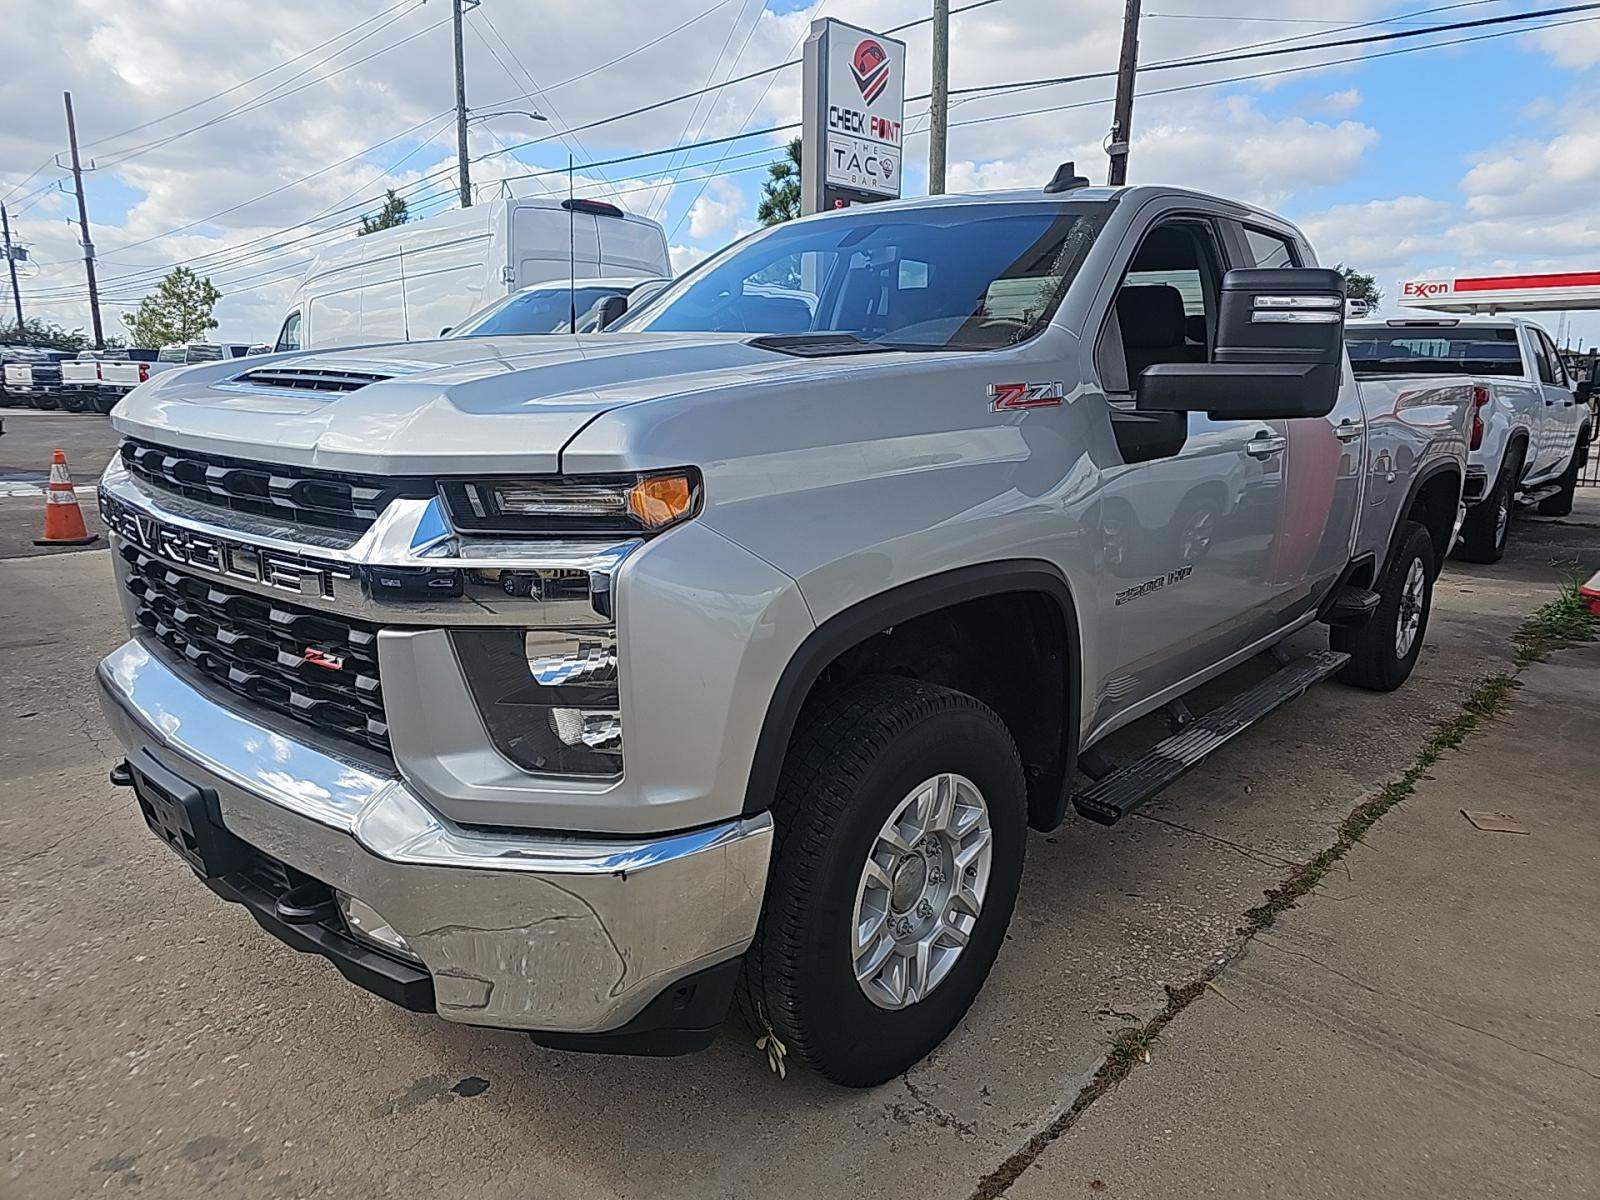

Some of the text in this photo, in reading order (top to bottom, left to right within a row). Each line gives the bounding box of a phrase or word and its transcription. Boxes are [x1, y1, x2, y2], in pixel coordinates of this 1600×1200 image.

[829, 105, 901, 143] CHECK POINT
[853, 141, 878, 155] THE
[851, 175, 878, 188] BAR
[1403, 282, 1449, 298] Exxon
[986, 381, 1064, 412] Z71
